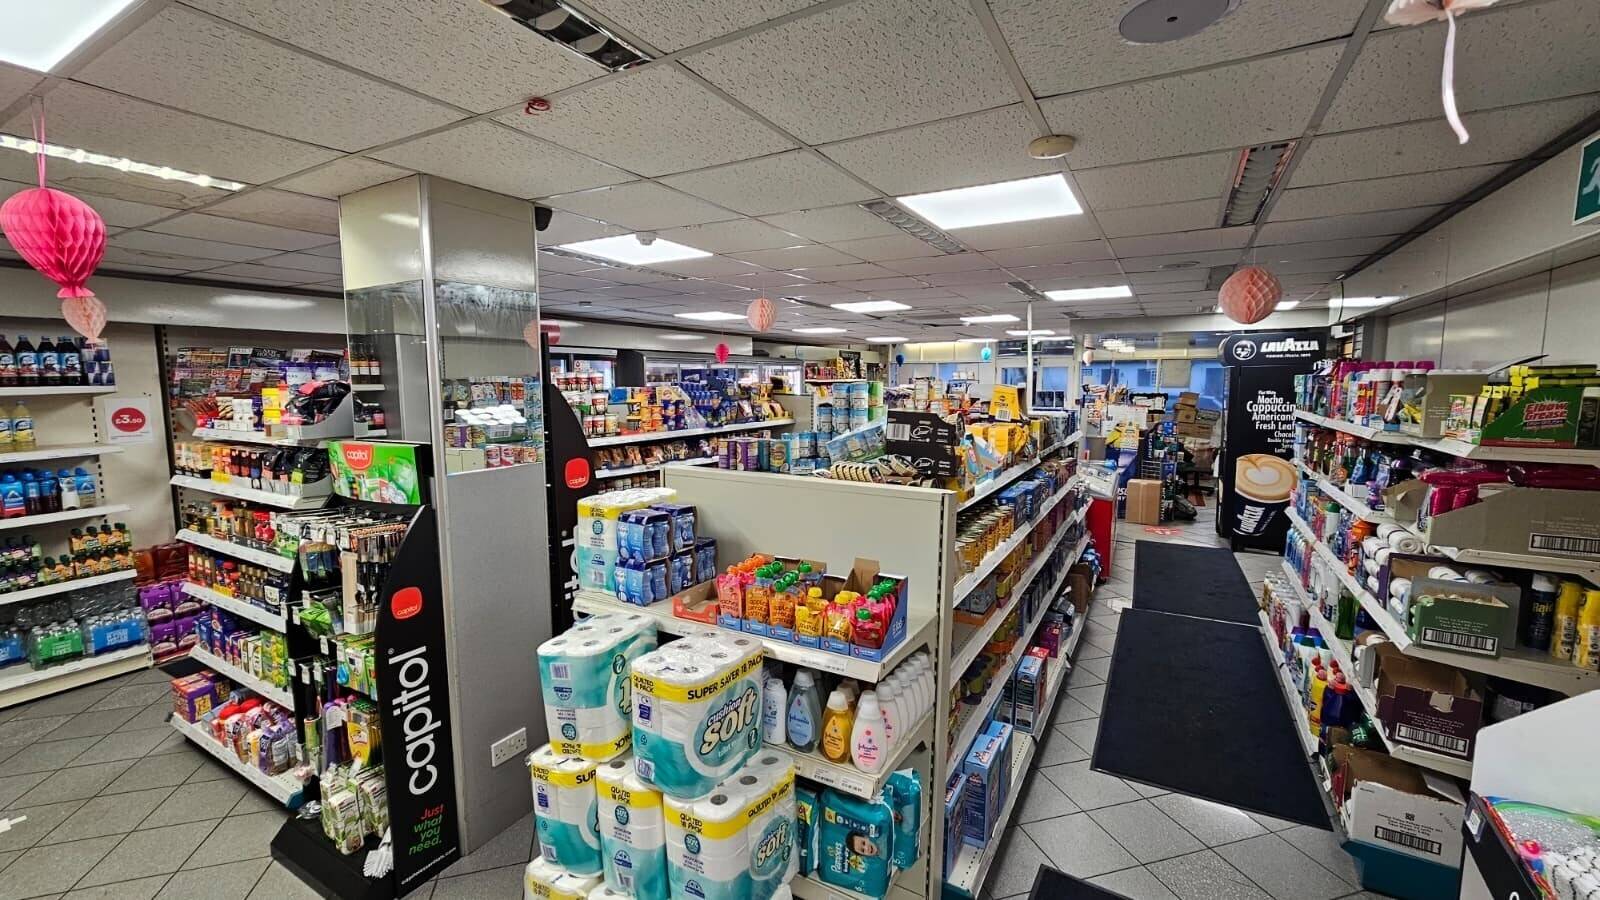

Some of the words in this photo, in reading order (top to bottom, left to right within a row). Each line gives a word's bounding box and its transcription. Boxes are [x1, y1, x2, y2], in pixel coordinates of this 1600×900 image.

[1260, 338, 1320, 353] LAVAZZA
[1257, 395, 1284, 404] Mocha
[1524, 410, 1568, 421] Grease
[1525, 402, 1568, 415] Elbow
[1252, 413, 1297, 421] Americano
[1255, 421, 1276, 430] Fresh
[1278, 421, 1296, 430] Leaf
[632, 674, 654, 687] QUILTED
[687, 682, 718, 700] SUPER
[719, 668, 740, 690] SAVER
[706, 696, 743, 728] cushion
[388, 645, 442, 796] capitol
[699, 686, 758, 756] soft
[575, 769, 597, 785] SUP
[420, 803, 444, 820] Just
[414, 814, 443, 833] what
[420, 826, 441, 842] you
[408, 836, 442, 856] need.
[757, 820, 789, 869] soft
